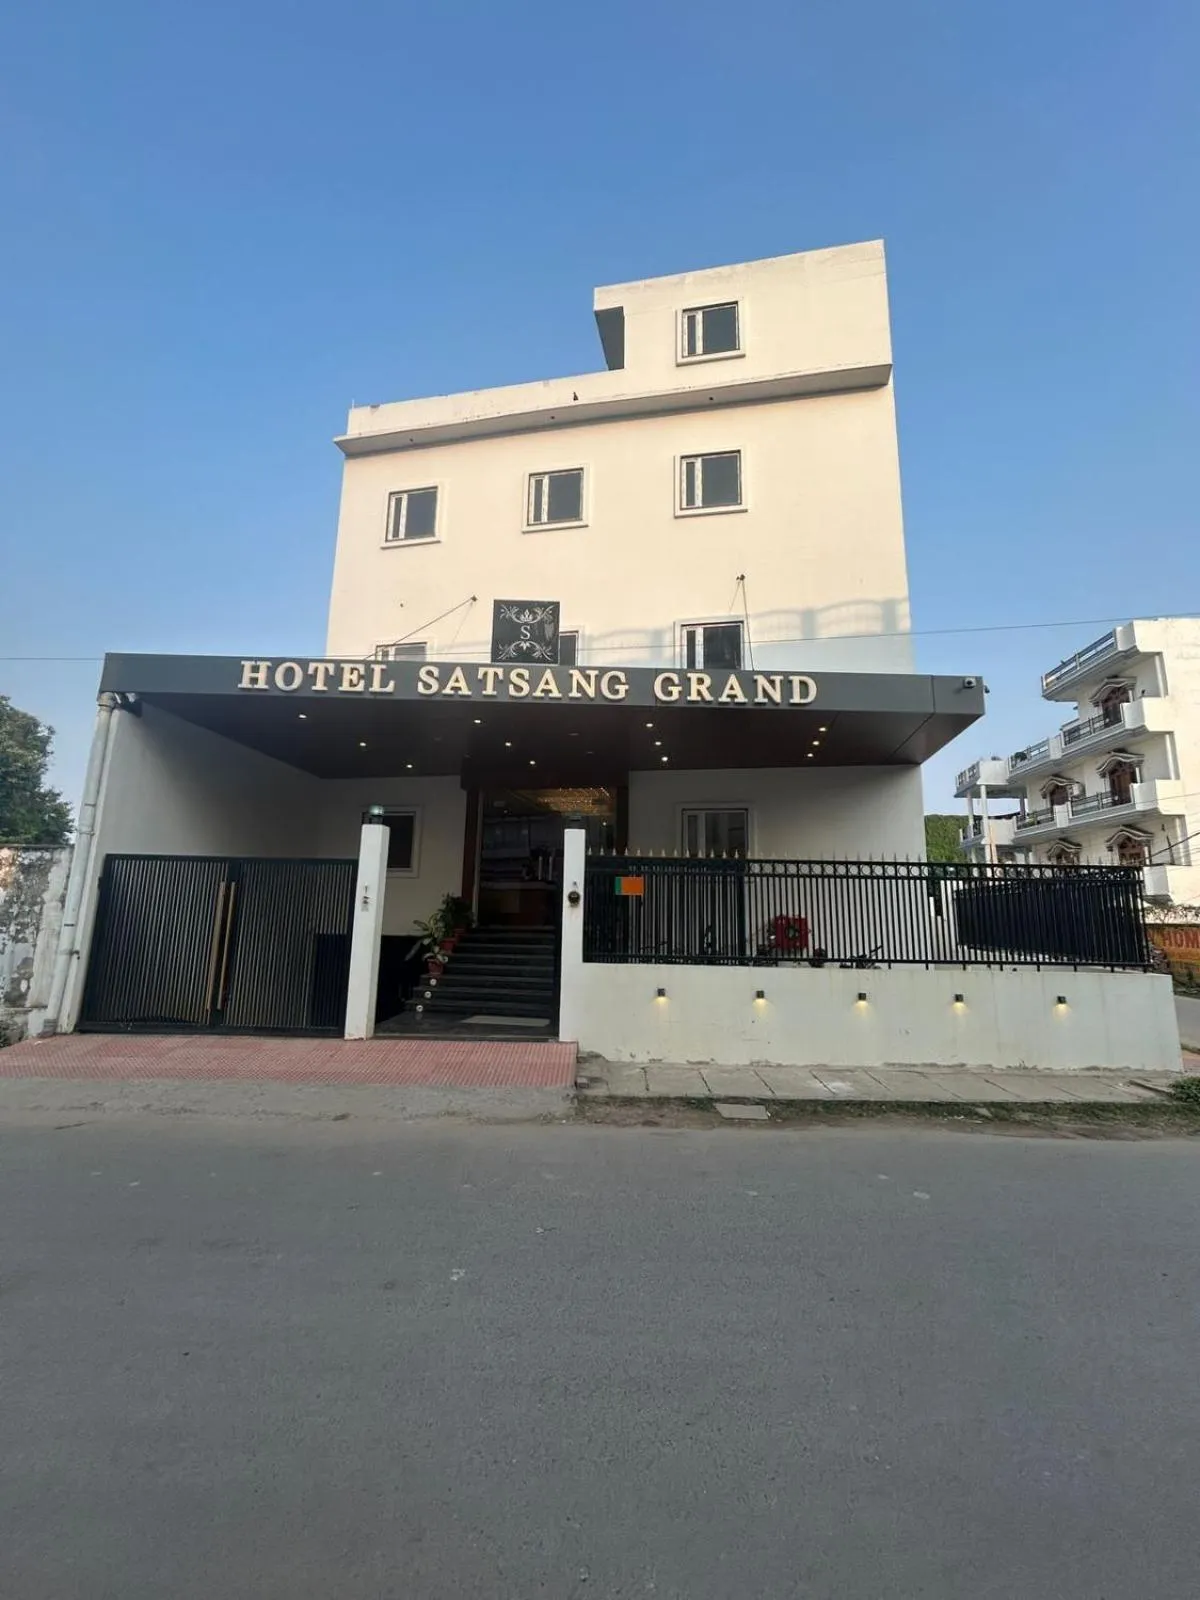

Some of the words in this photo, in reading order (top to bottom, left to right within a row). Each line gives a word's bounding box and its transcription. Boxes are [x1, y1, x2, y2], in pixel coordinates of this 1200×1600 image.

[520, 625, 531, 640] S
[237, 660, 396, 693] HOTEL
[417, 665, 629, 700] SATSANG
[653, 671, 818, 704] GRAND
